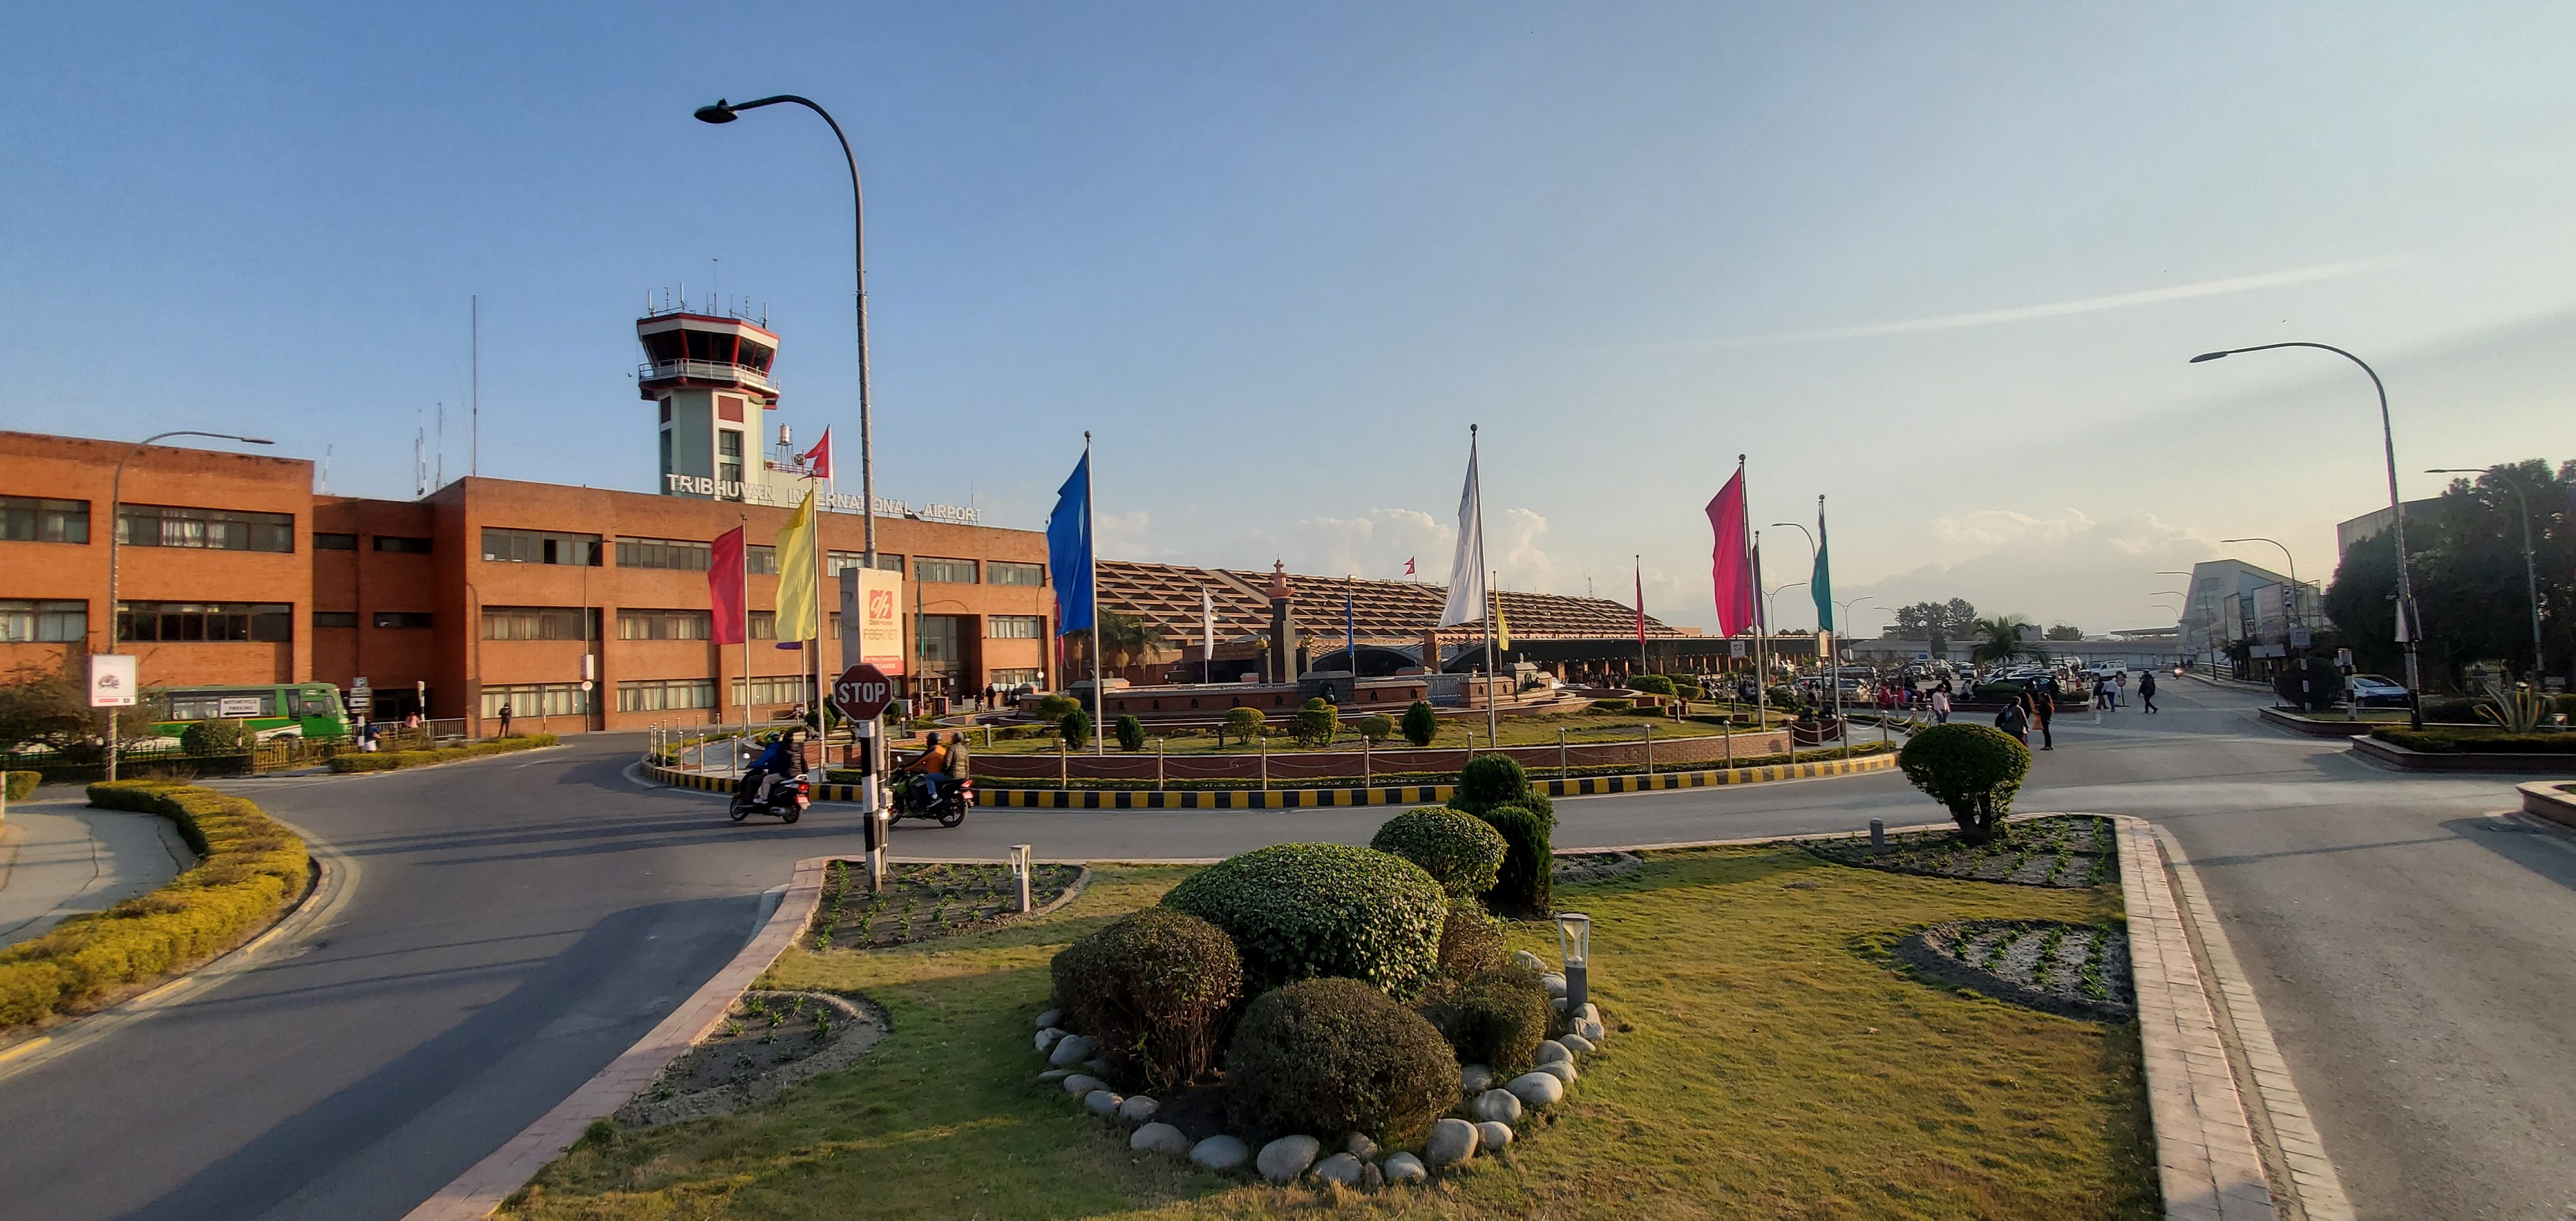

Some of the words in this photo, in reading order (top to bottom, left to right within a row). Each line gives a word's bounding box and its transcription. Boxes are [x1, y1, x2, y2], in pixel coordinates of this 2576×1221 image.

[666, 473, 774, 501] TRIBHUVAN
[788, 488, 914, 515] INERNATONAL
[924, 503, 982, 521] AIRPORT
[839, 682, 886, 704] STOP
